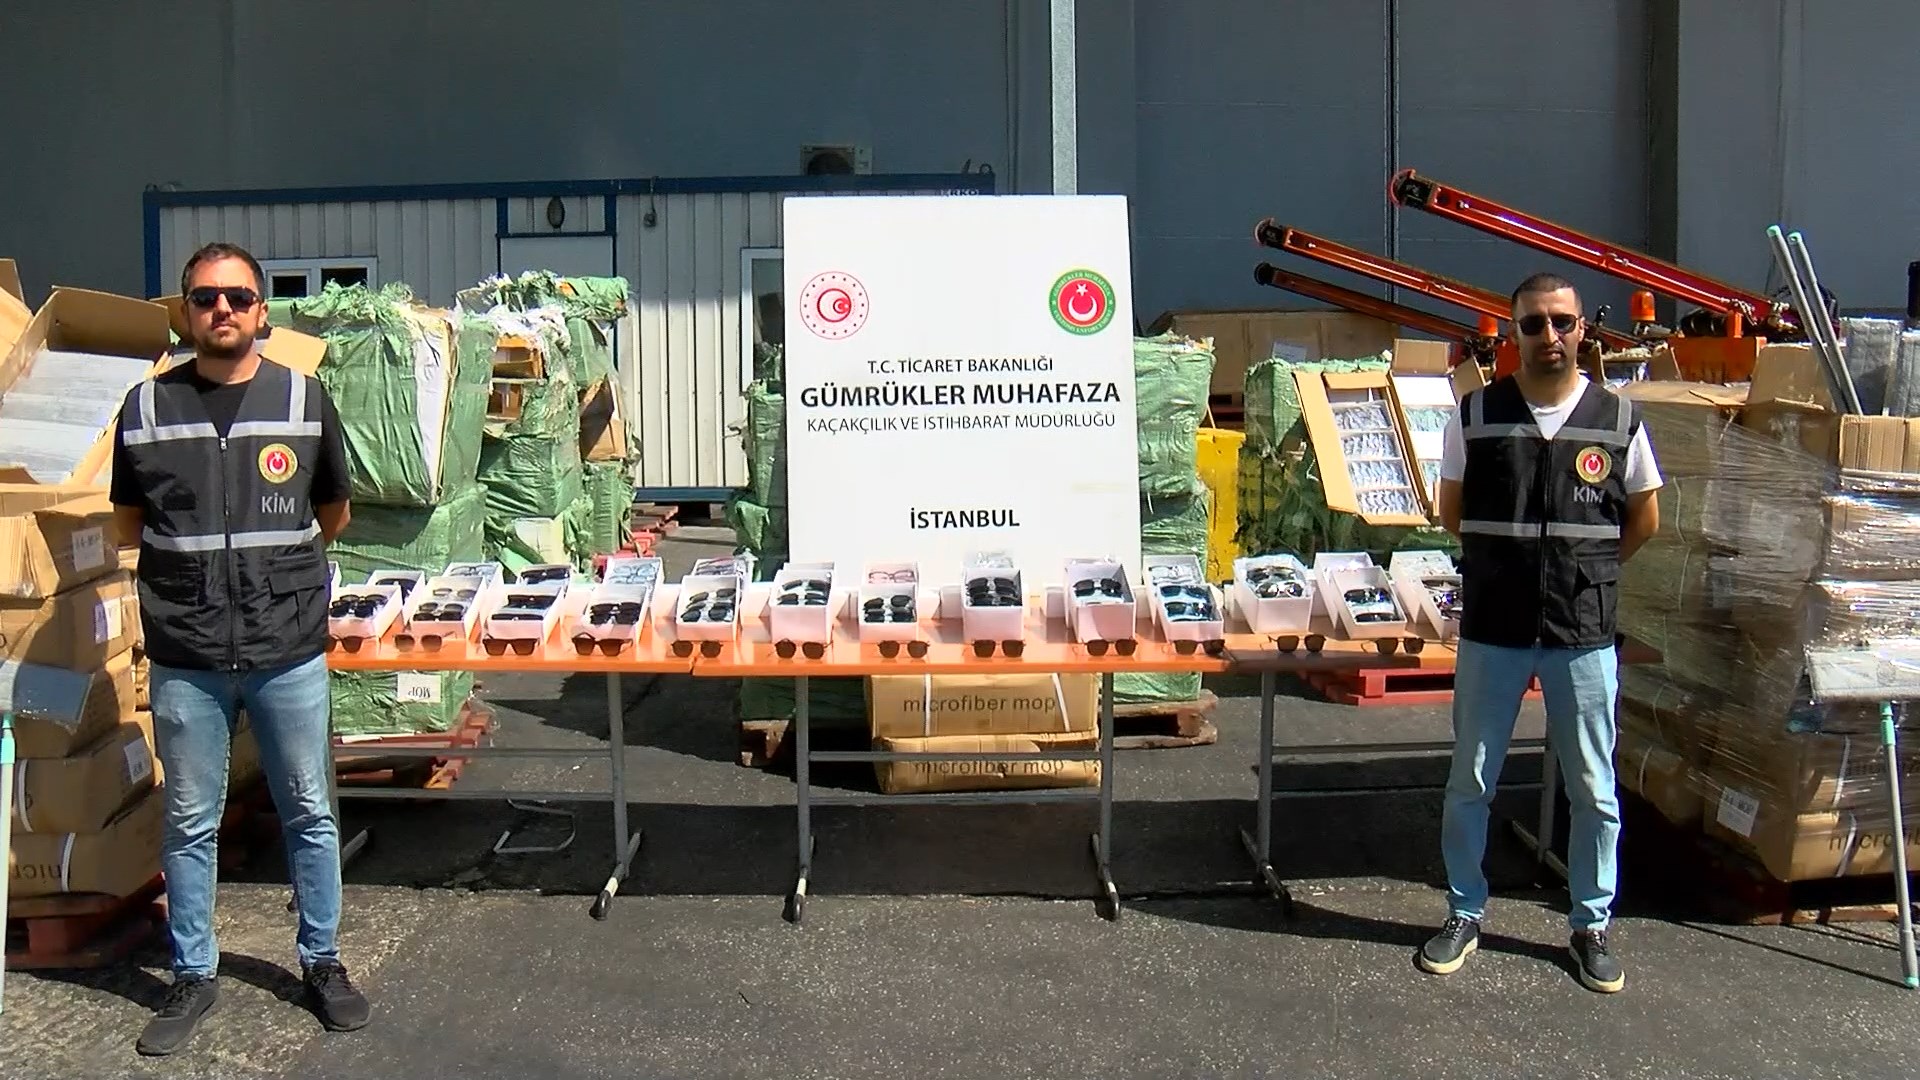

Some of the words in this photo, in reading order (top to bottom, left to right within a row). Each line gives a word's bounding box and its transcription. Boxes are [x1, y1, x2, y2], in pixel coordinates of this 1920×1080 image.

[867, 360, 895, 374] T.C.
[898, 357, 963, 373] TİCARET
[968, 355, 1053, 372] BAKANLIĞI
[800, 381, 966, 407] GÜMRÜKLER
[973, 382, 1121, 405] MUHAFAZA
[807, 417, 898, 435] KAÇAKÇILIK
[901, 416, 919, 431] VE
[923, 413, 1011, 431] İSTİHBARAT
[1015, 411, 1116, 428] MÜDÜRLÜĞÜ
[262, 492, 295, 513] KİM
[910, 508, 1020, 529] İSTANBUL
[1013, 696, 1056, 714] mop
